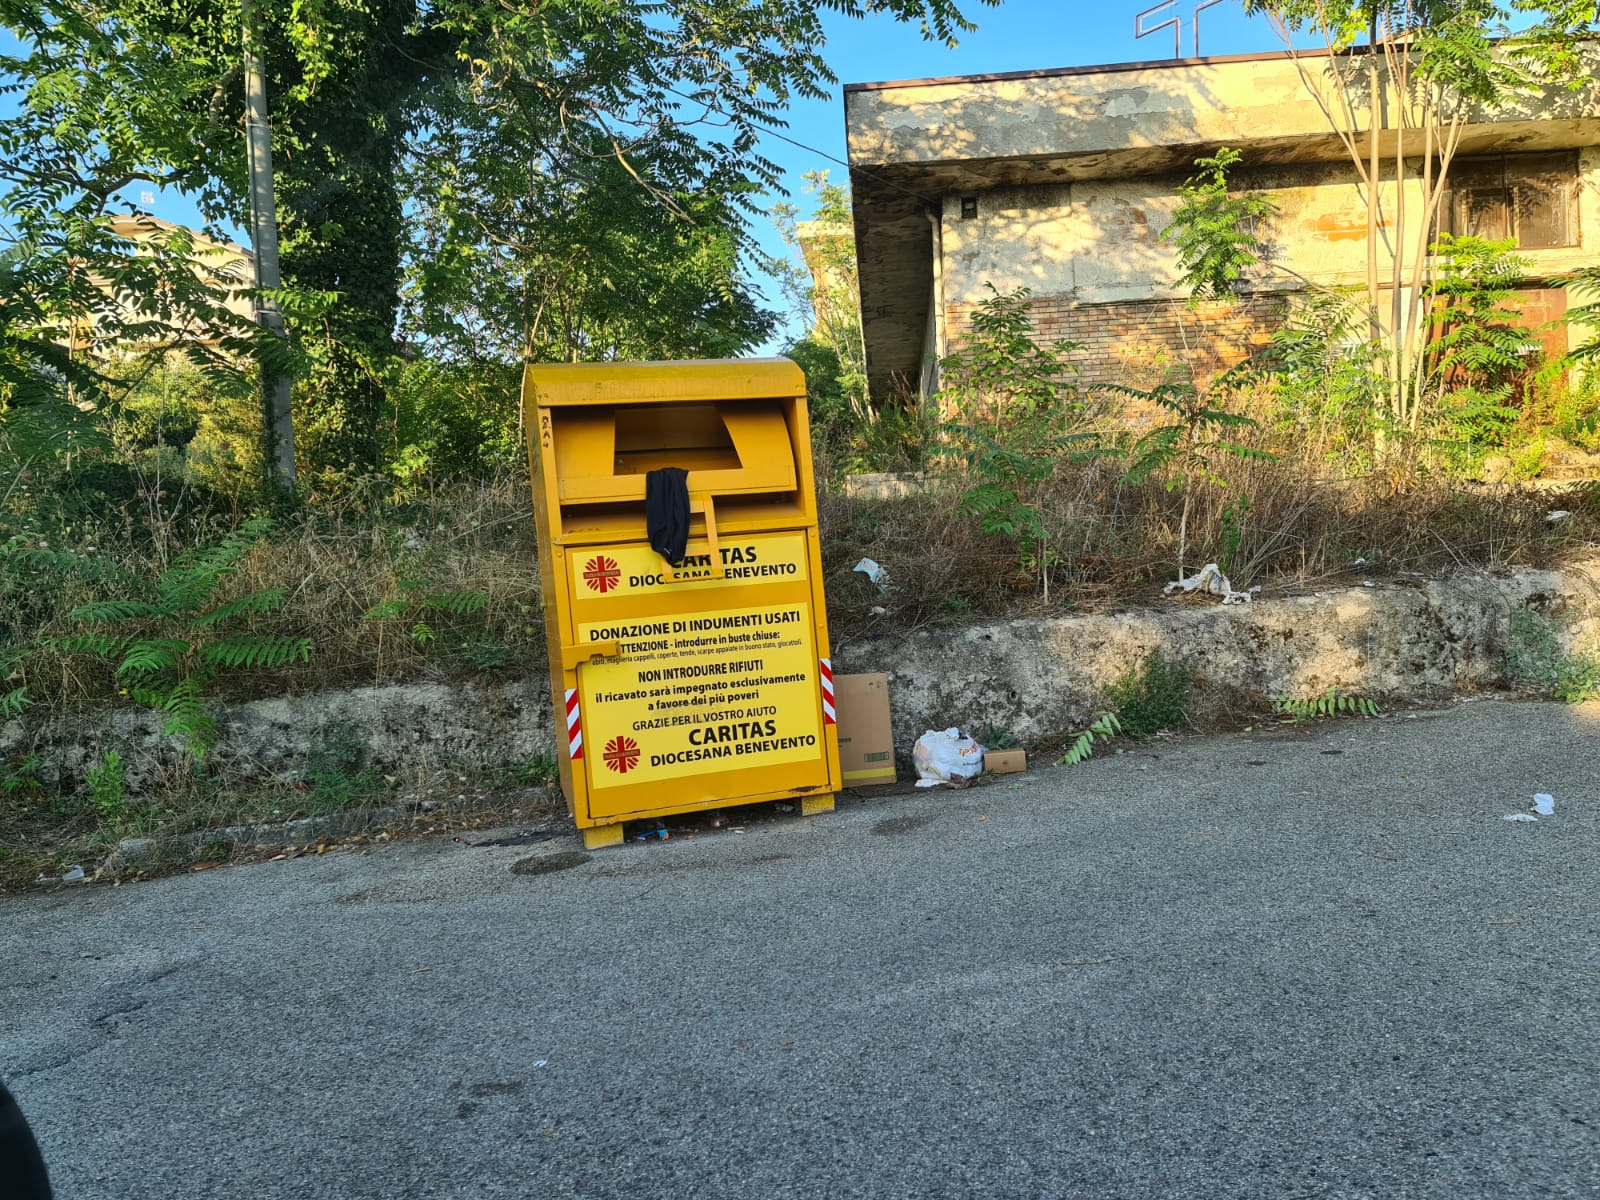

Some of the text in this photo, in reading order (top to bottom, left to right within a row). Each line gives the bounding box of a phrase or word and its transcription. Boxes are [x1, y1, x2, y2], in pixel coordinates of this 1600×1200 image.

[672, 546, 757, 569] ARTAS
[629, 570, 711, 587] DIOCSANA
[724, 563, 797, 579] ENEVENTO
[590, 610, 800, 641] DONAZIONE DI INDUMENTI USATI
[621, 640, 668, 654] TTENZIONE
[674, 637, 717, 649] introdurre
[719, 634, 726, 644] in
[728, 633, 750, 643] buste
[752, 631, 780, 641] chiuse:
[697, 647, 714, 657] scarpe
[716, 644, 738, 655] appaiate
[638, 659, 763, 683] NON INTRODURRE RIFIUTI
[595, 673, 805, 703] il ricavato sarà impegnato esclusivamente
[648, 689, 759, 710] a favore dei più poveri
[632, 705, 776, 731] GRAZIE PER IL VOSTRO AIUTO
[688, 719, 776, 746] CARITAS
[651, 734, 816, 767] DIOCESANA BENEVENTO
